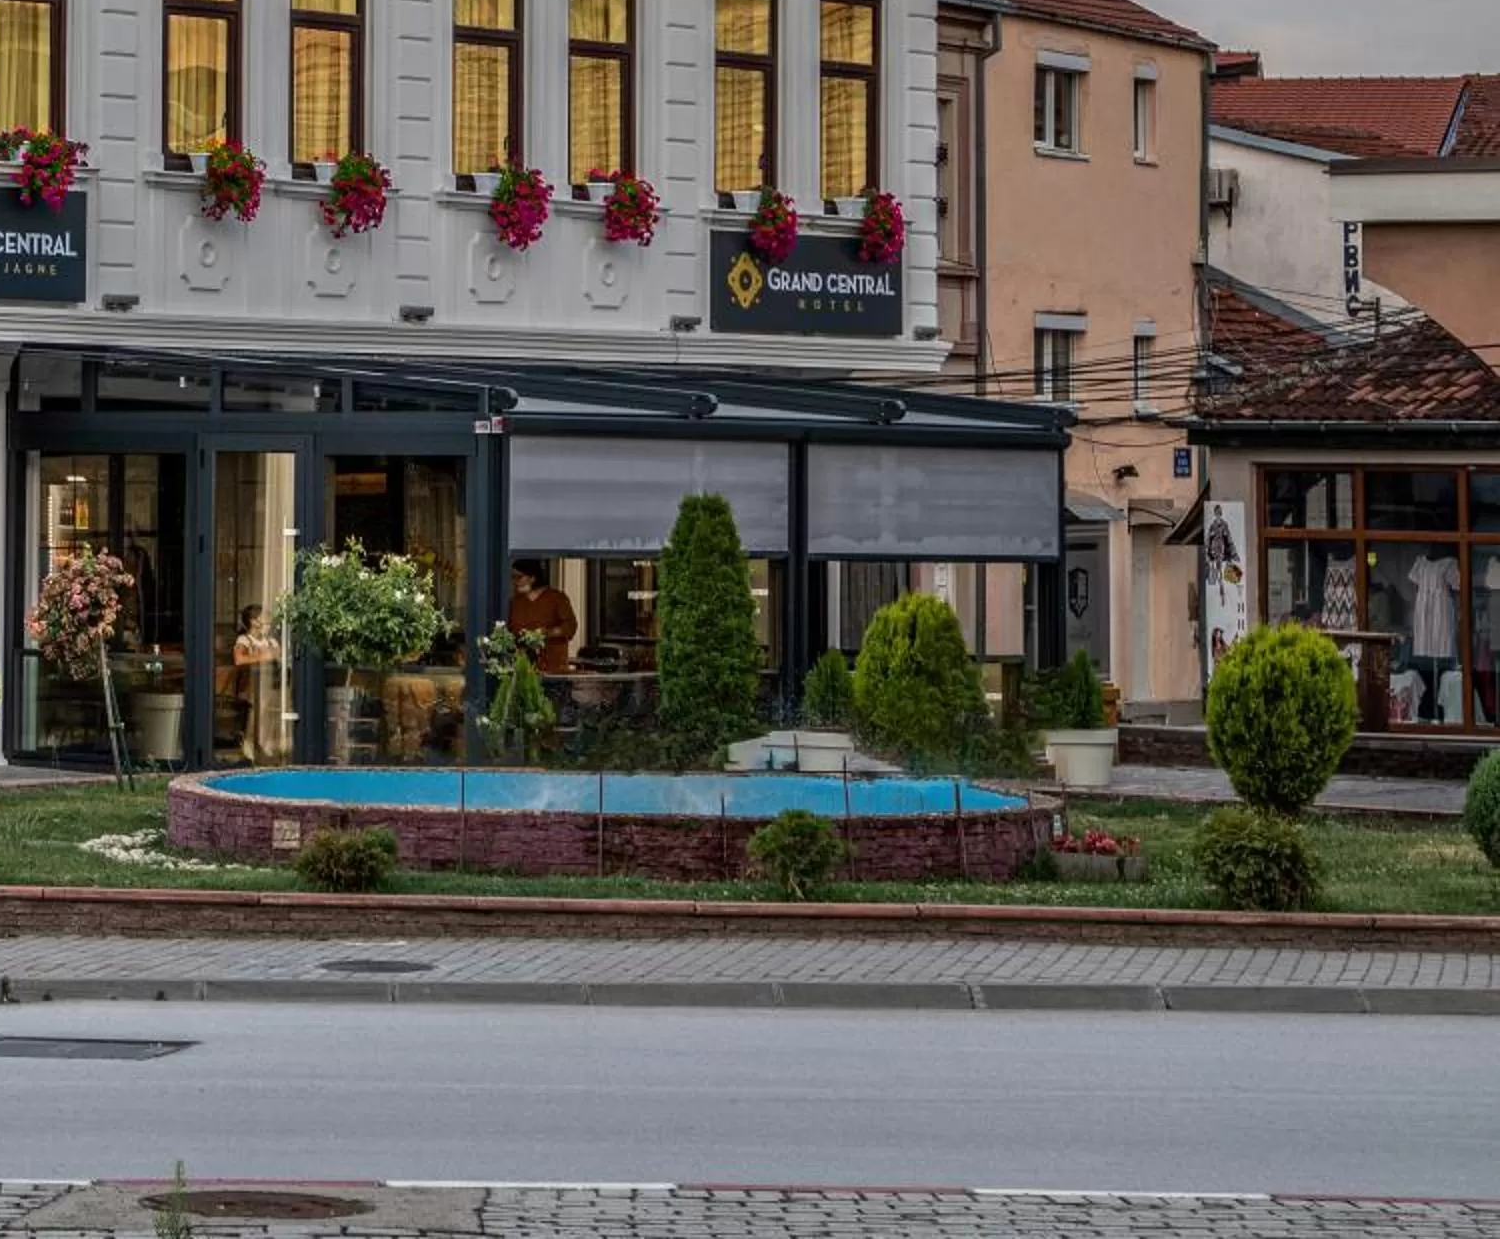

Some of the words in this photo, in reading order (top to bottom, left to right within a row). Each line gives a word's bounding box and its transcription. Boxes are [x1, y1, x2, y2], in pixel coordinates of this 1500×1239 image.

[3, 262, 57, 275] JAGNE
[767, 267, 823, 292] GRAND
[827, 272, 895, 295] CENTRAL
